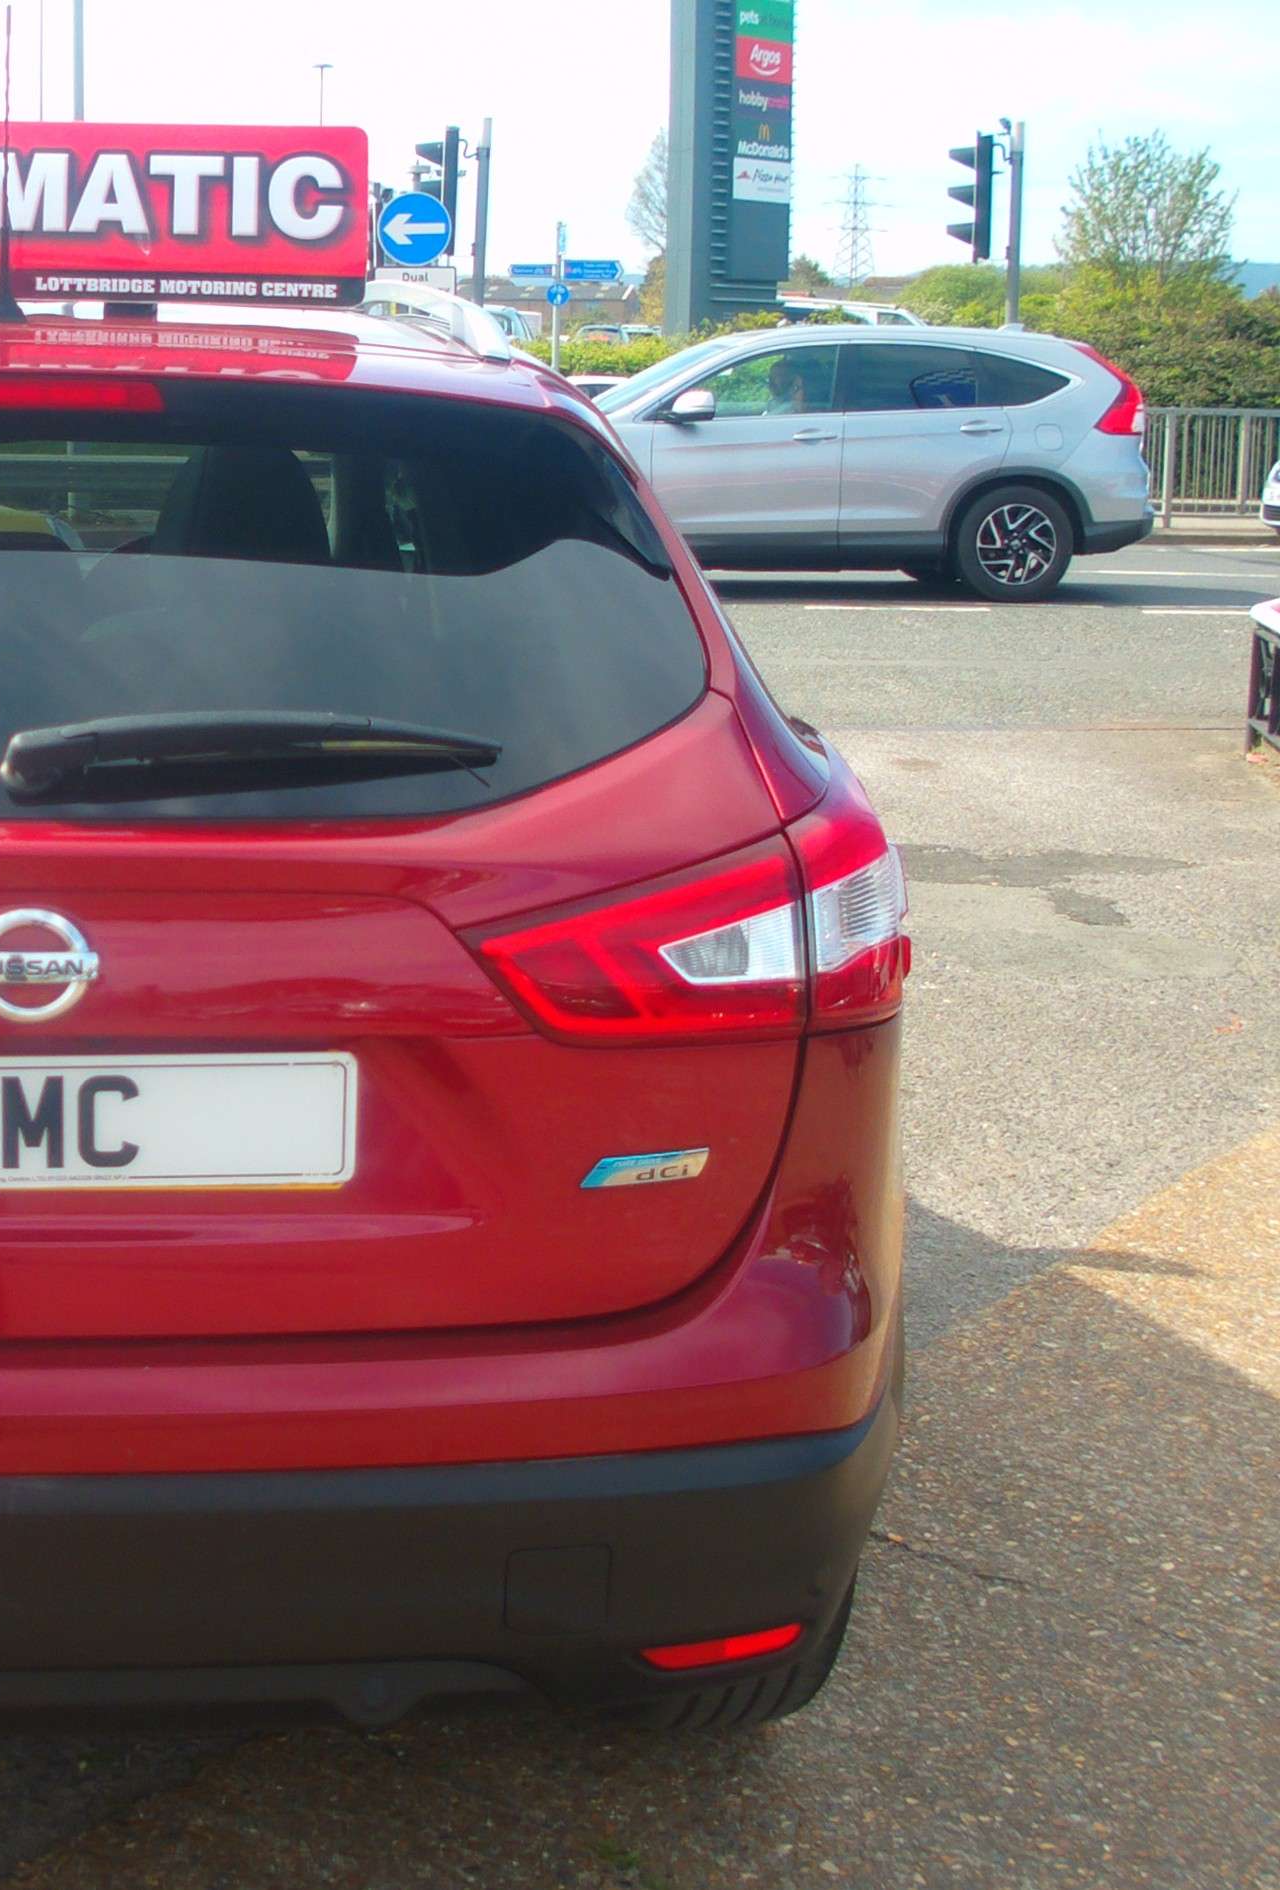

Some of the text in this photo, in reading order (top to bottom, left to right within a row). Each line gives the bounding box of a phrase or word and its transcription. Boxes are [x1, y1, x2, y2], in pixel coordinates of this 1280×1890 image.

[749, 43, 781, 68] Argos
[737, 140, 790, 160] McDonald's
[35, 276, 338, 298] LOTTBRIDGE MOTORING CENTRE
[401, 272, 429, 282] Dual
[635, 1164, 689, 1181] dCi
